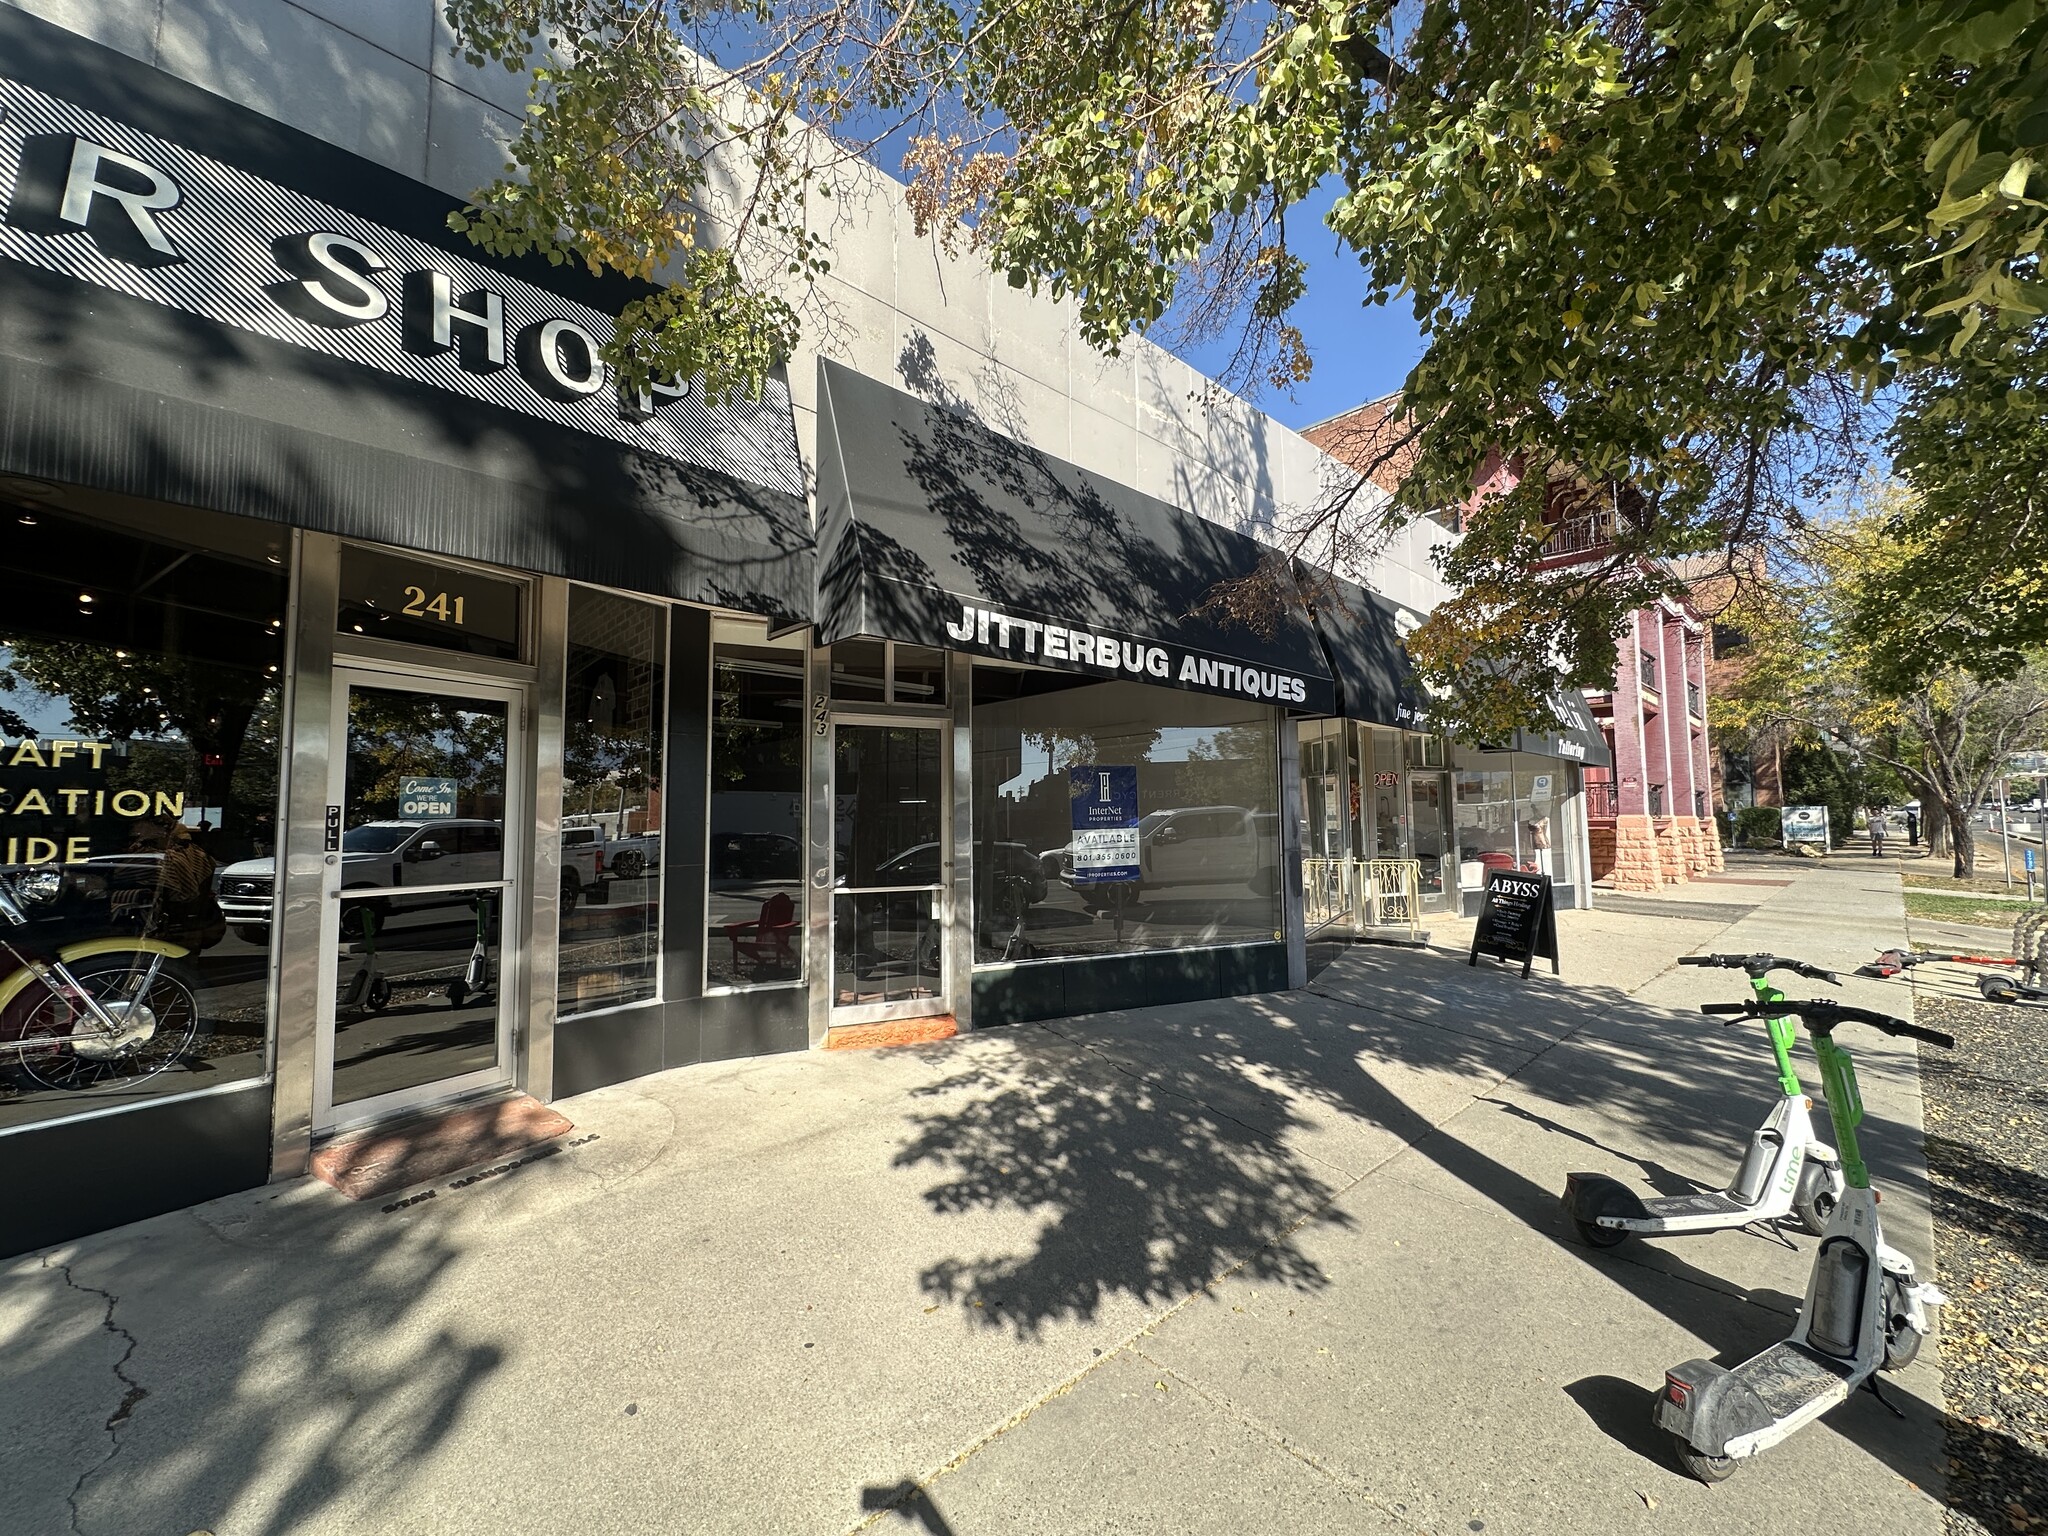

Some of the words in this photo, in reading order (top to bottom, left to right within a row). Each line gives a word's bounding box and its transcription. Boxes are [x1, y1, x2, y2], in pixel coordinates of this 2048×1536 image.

[402, 585, 464, 625] 241
[946, 606, 1170, 679] JITTERBUG
[1178, 654, 1306, 703] ANTIQUES
[814, 696, 827, 735] 243
[0, 738, 112, 769] AFT
[406, 780, 435, 794] Come
[436, 782, 452, 794] In
[1374, 773, 1399, 786] OPEN
[0, 788, 184, 817] ATION
[404, 801, 451, 815] OPEN
[416, 794, 438, 802] WE'RE
[1088, 806, 1122, 815] InterNet
[327, 806, 339, 850] PULL
[1077, 833, 1136, 845] AVAILABLE
[1076, 851, 1136, 862] 801.355.0600
[1488, 878, 1540, 898] ABYSS
[381, 1189, 437, 1215] STAY
[448, 1146, 563, 1190] HANDSOME
[568, 1133, 601, 1148] SLC
[1778, 1144, 1802, 1195] Lime
